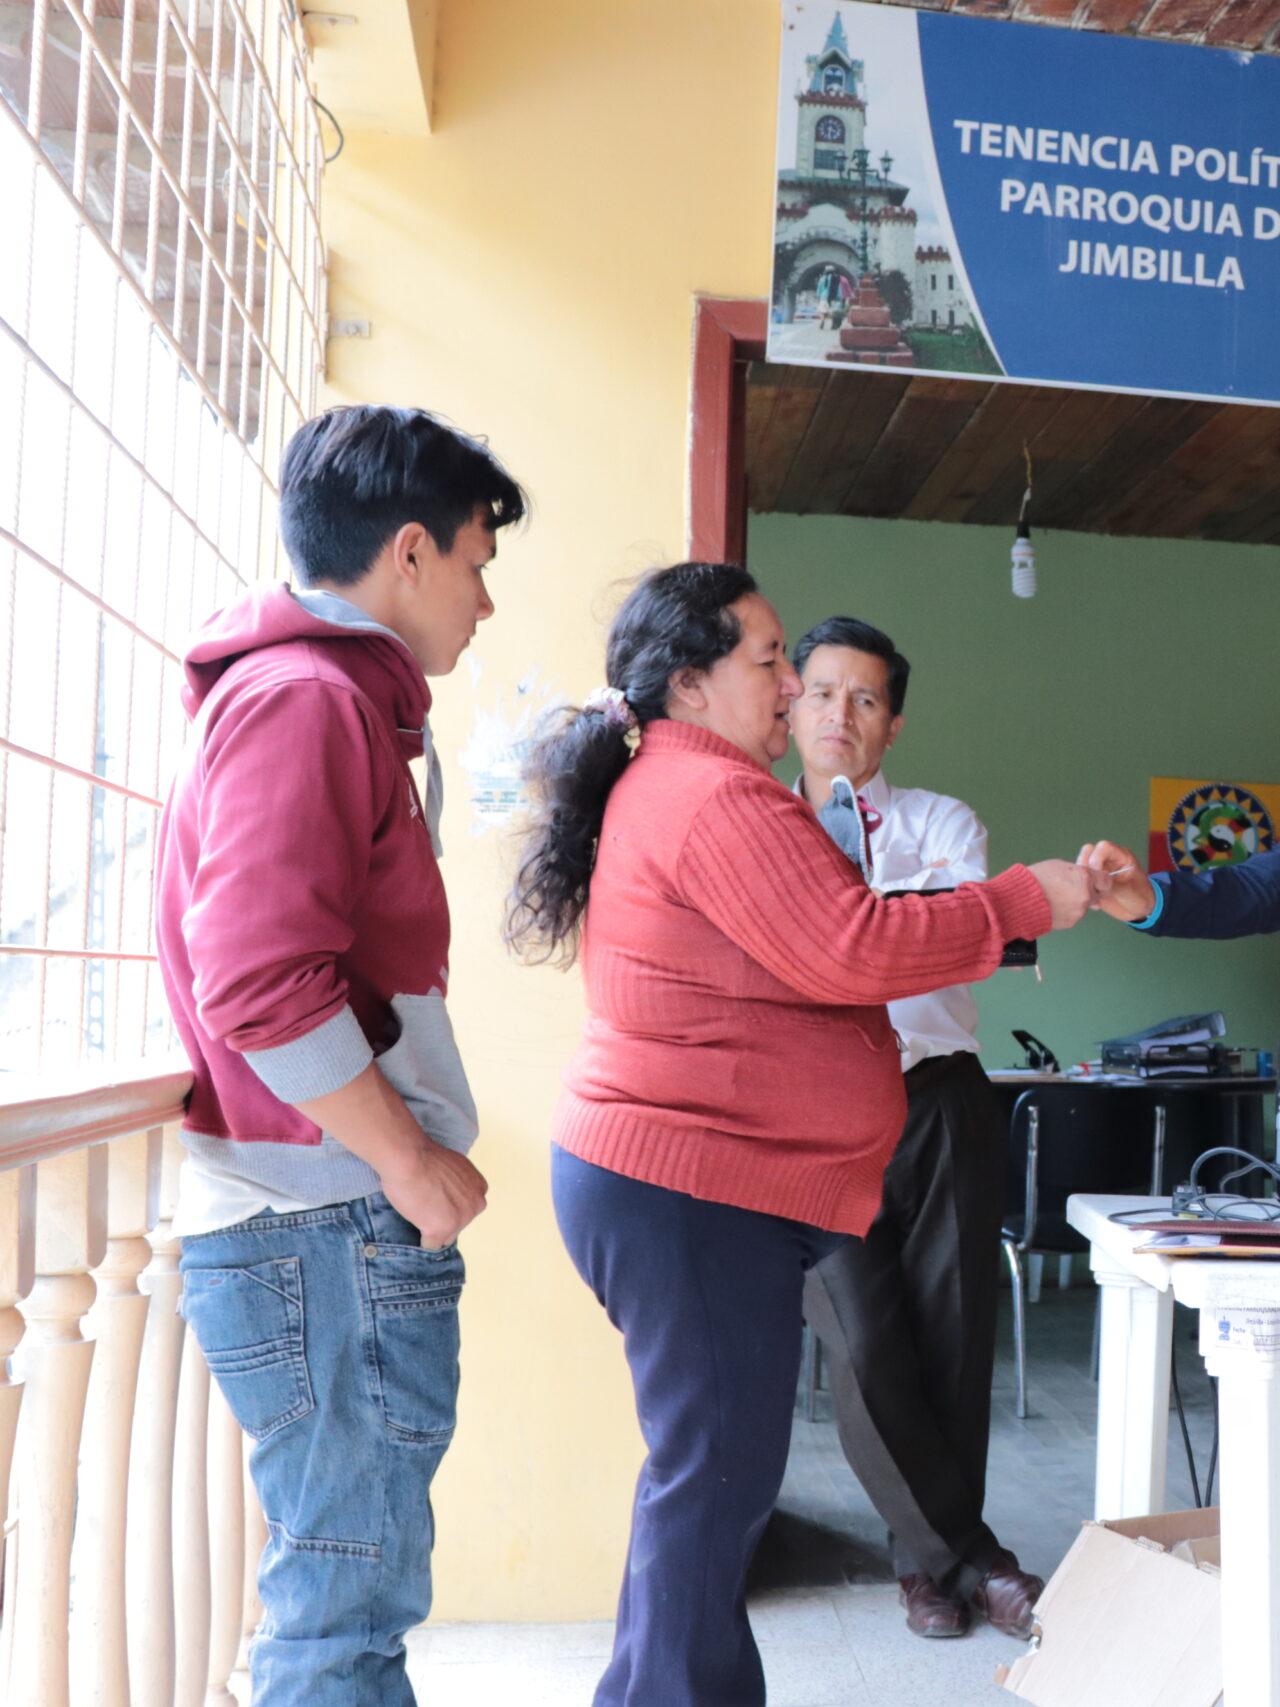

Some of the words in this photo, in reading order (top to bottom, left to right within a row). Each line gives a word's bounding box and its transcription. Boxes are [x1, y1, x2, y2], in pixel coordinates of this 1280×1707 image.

[953, 119, 1159, 174] TENENCIA
[1000, 178, 1243, 237] PARROQUIA
[1058, 239, 1246, 291] JIMBILLA
